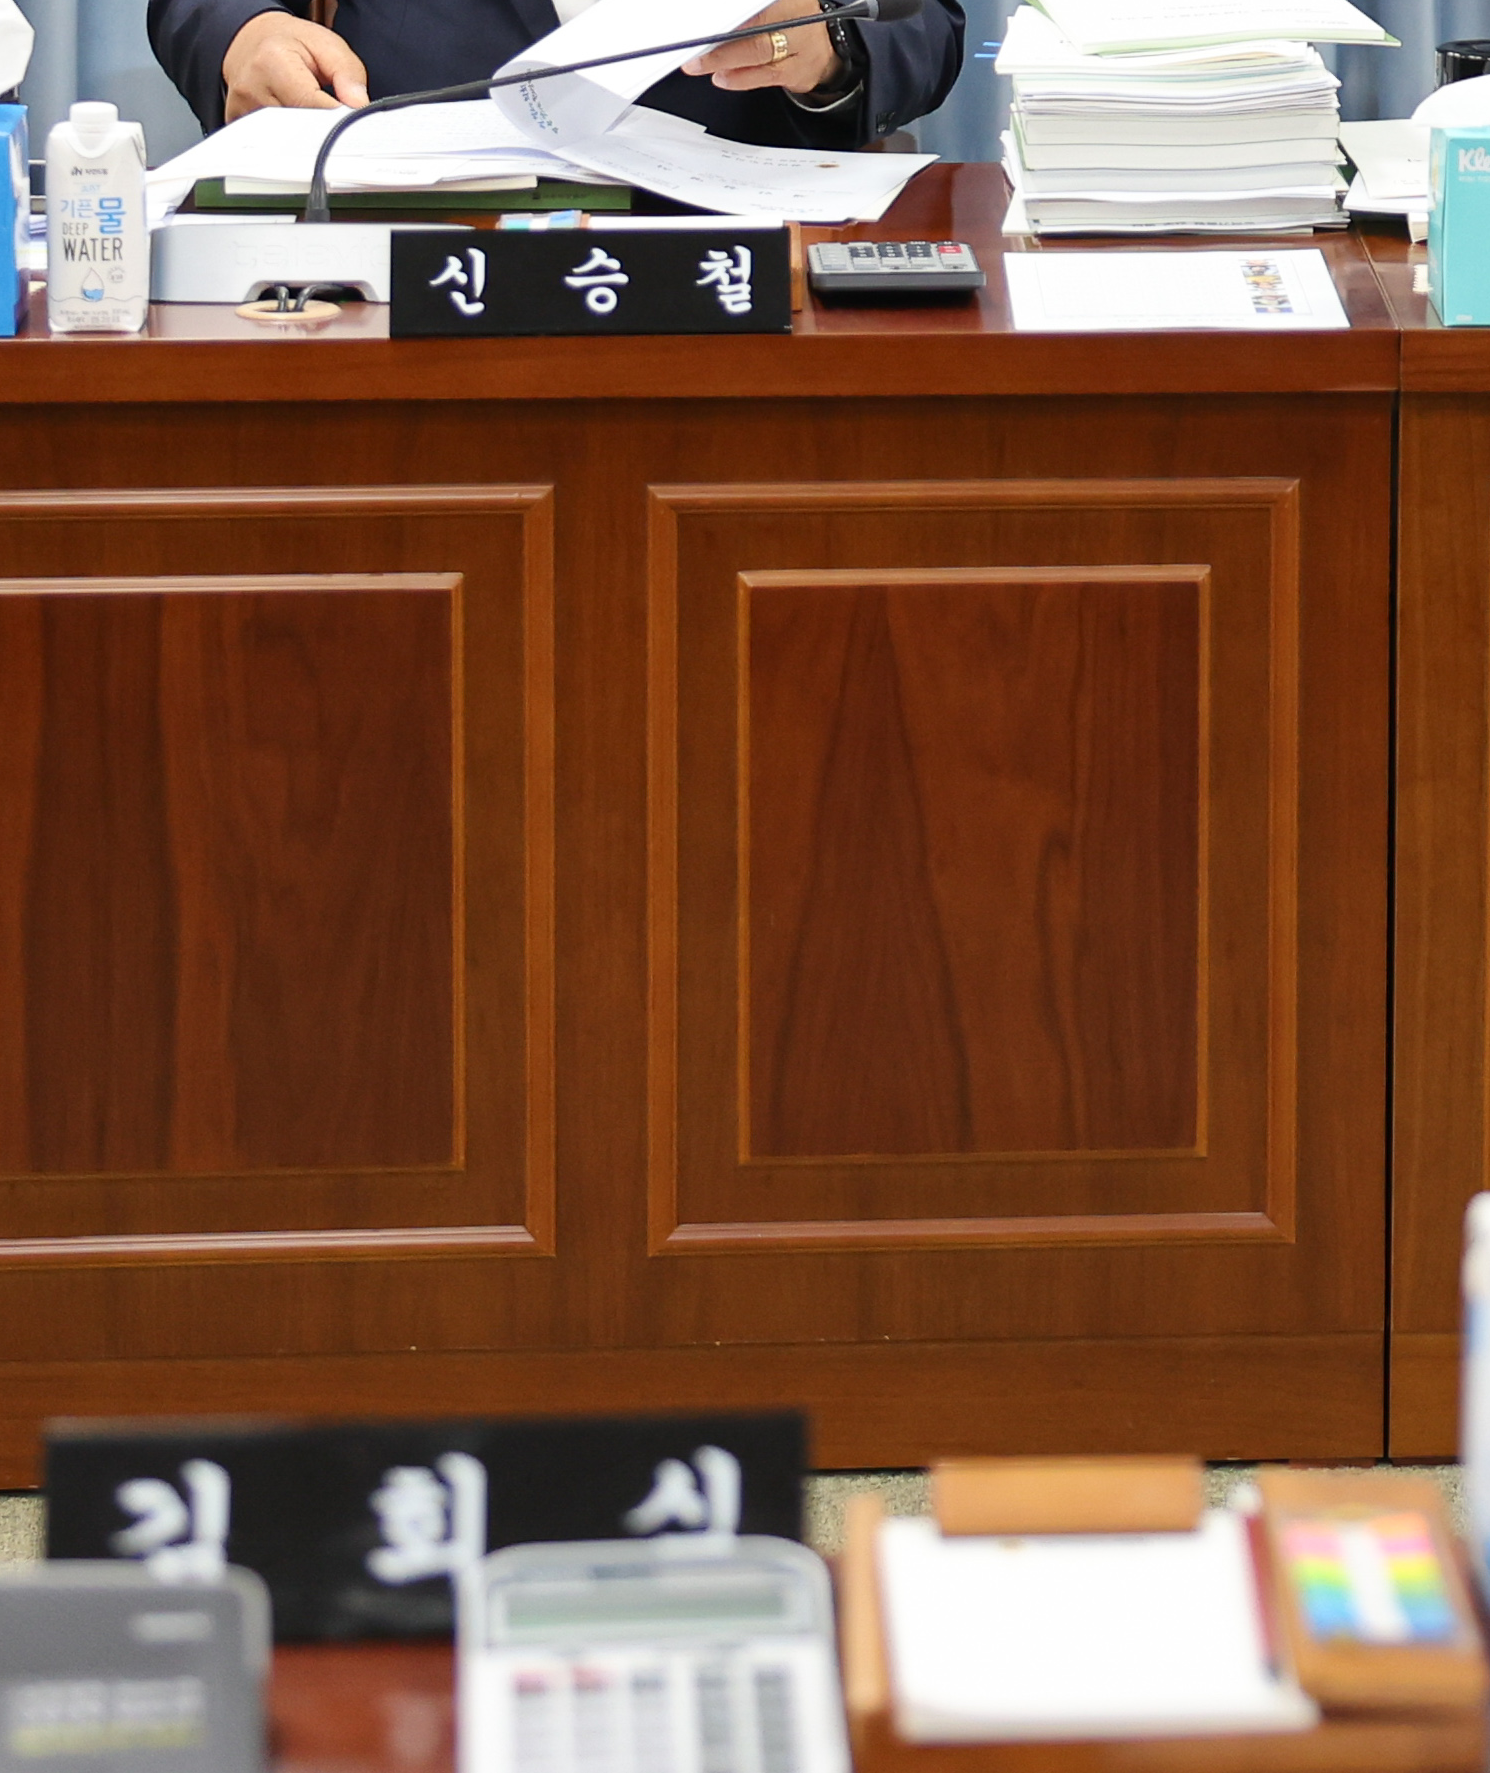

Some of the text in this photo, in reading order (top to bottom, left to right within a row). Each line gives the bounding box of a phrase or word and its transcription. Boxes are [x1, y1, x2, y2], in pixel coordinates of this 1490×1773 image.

[62, 222, 89, 235] DEEP
[63, 238, 123, 262] WATER
[429, 245, 753, 316] 신승철
